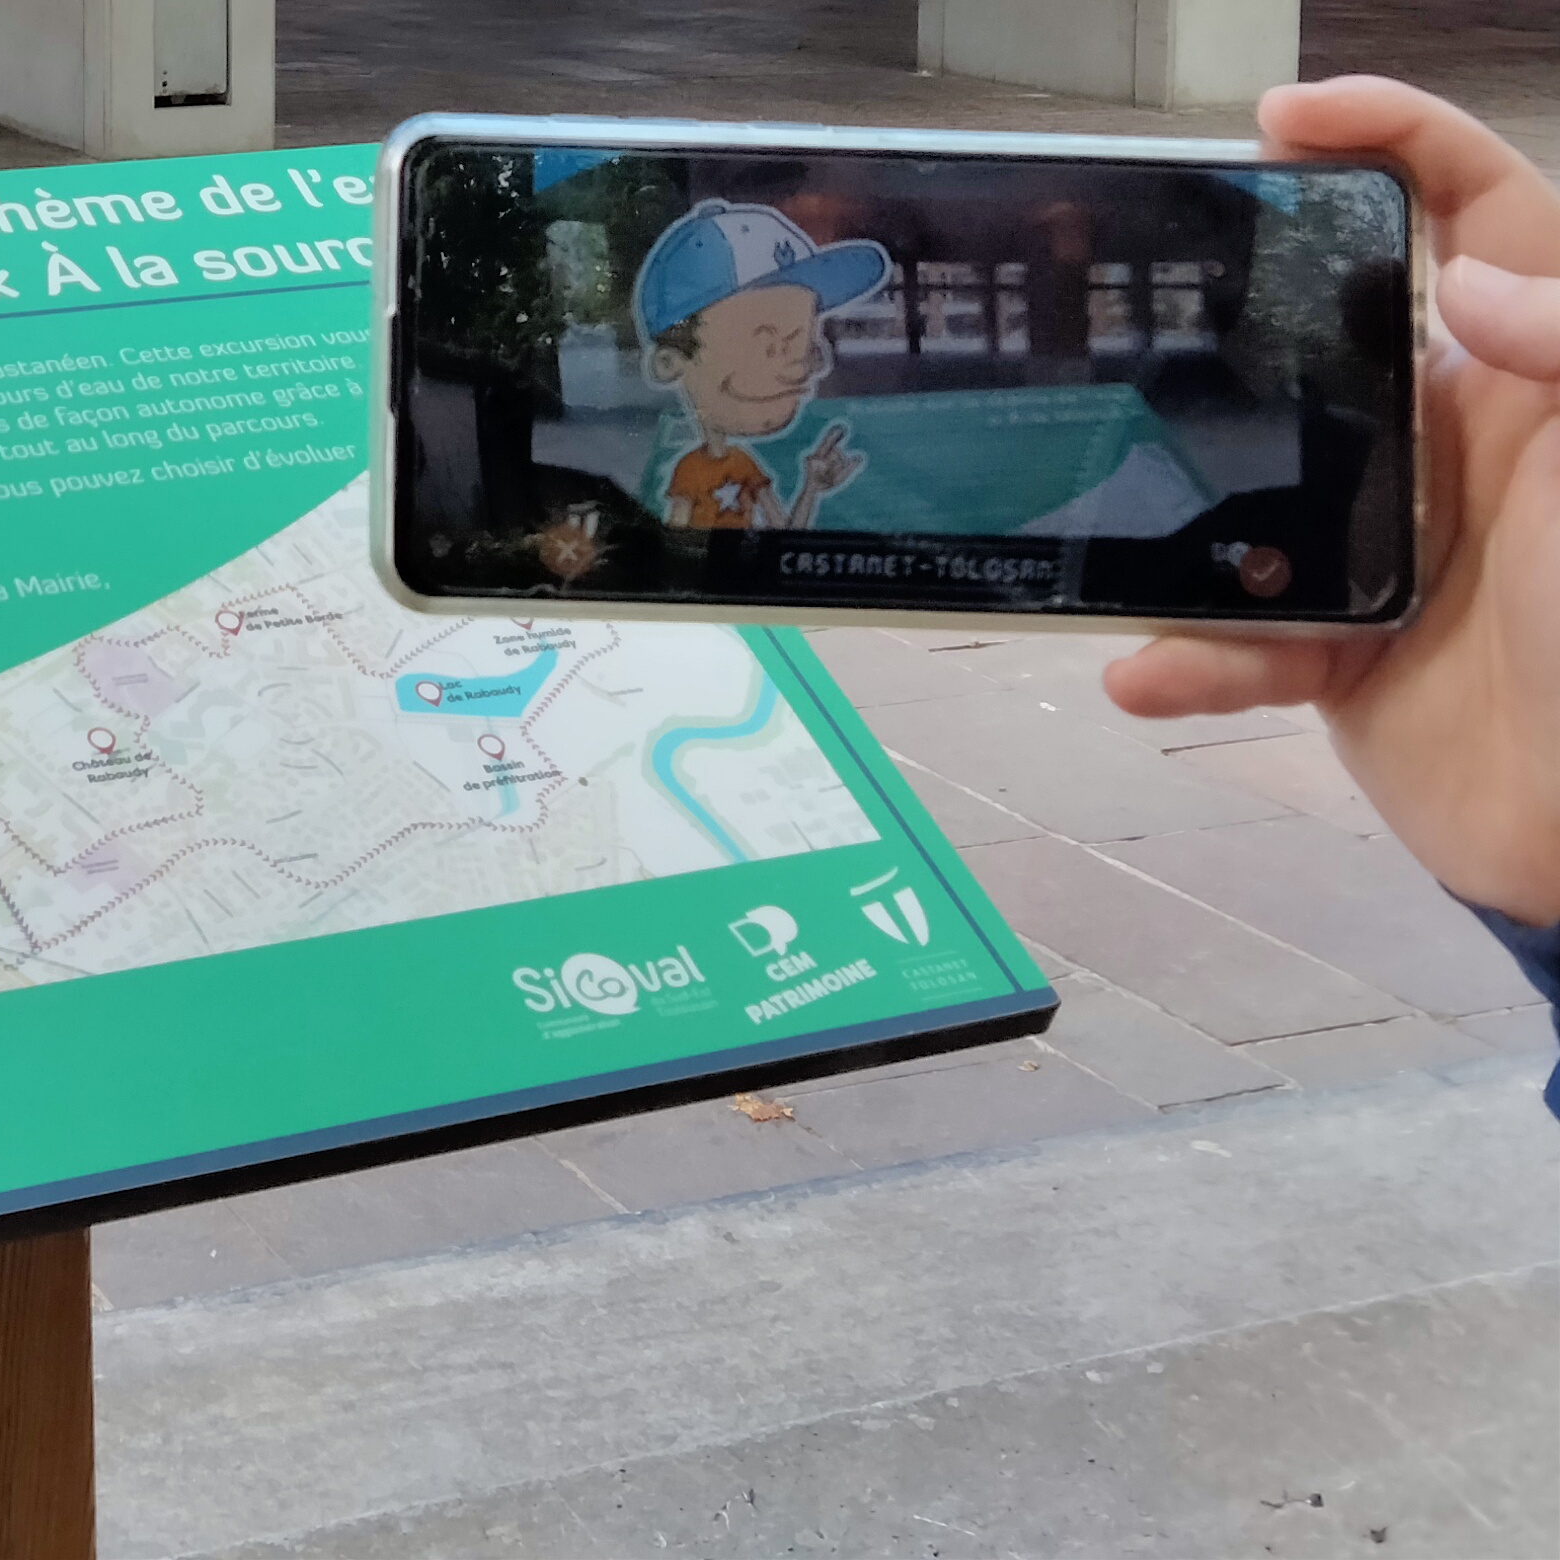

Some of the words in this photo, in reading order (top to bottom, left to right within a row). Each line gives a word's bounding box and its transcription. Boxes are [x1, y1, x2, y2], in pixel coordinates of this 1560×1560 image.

[200, 175, 281, 215] de
[42, 241, 100, 295] À
[106, 247, 178, 288] la
[119, 346, 193, 365] Cette
[199, 334, 317, 357] excursion
[56, 380, 125, 399] d'eau
[131, 372, 162, 391] de
[169, 367, 238, 387] notre
[243, 354, 362, 379] territoire.
[66, 437, 99, 453] au
[102, 430, 163, 449] long
[166, 422, 200, 442] du
[205, 412, 324, 442] parcours.
[13, 572, 110, 598] Mairie,
[765, 950, 818, 982] CEM
[744, 958, 877, 1025] PATRIMOINE
